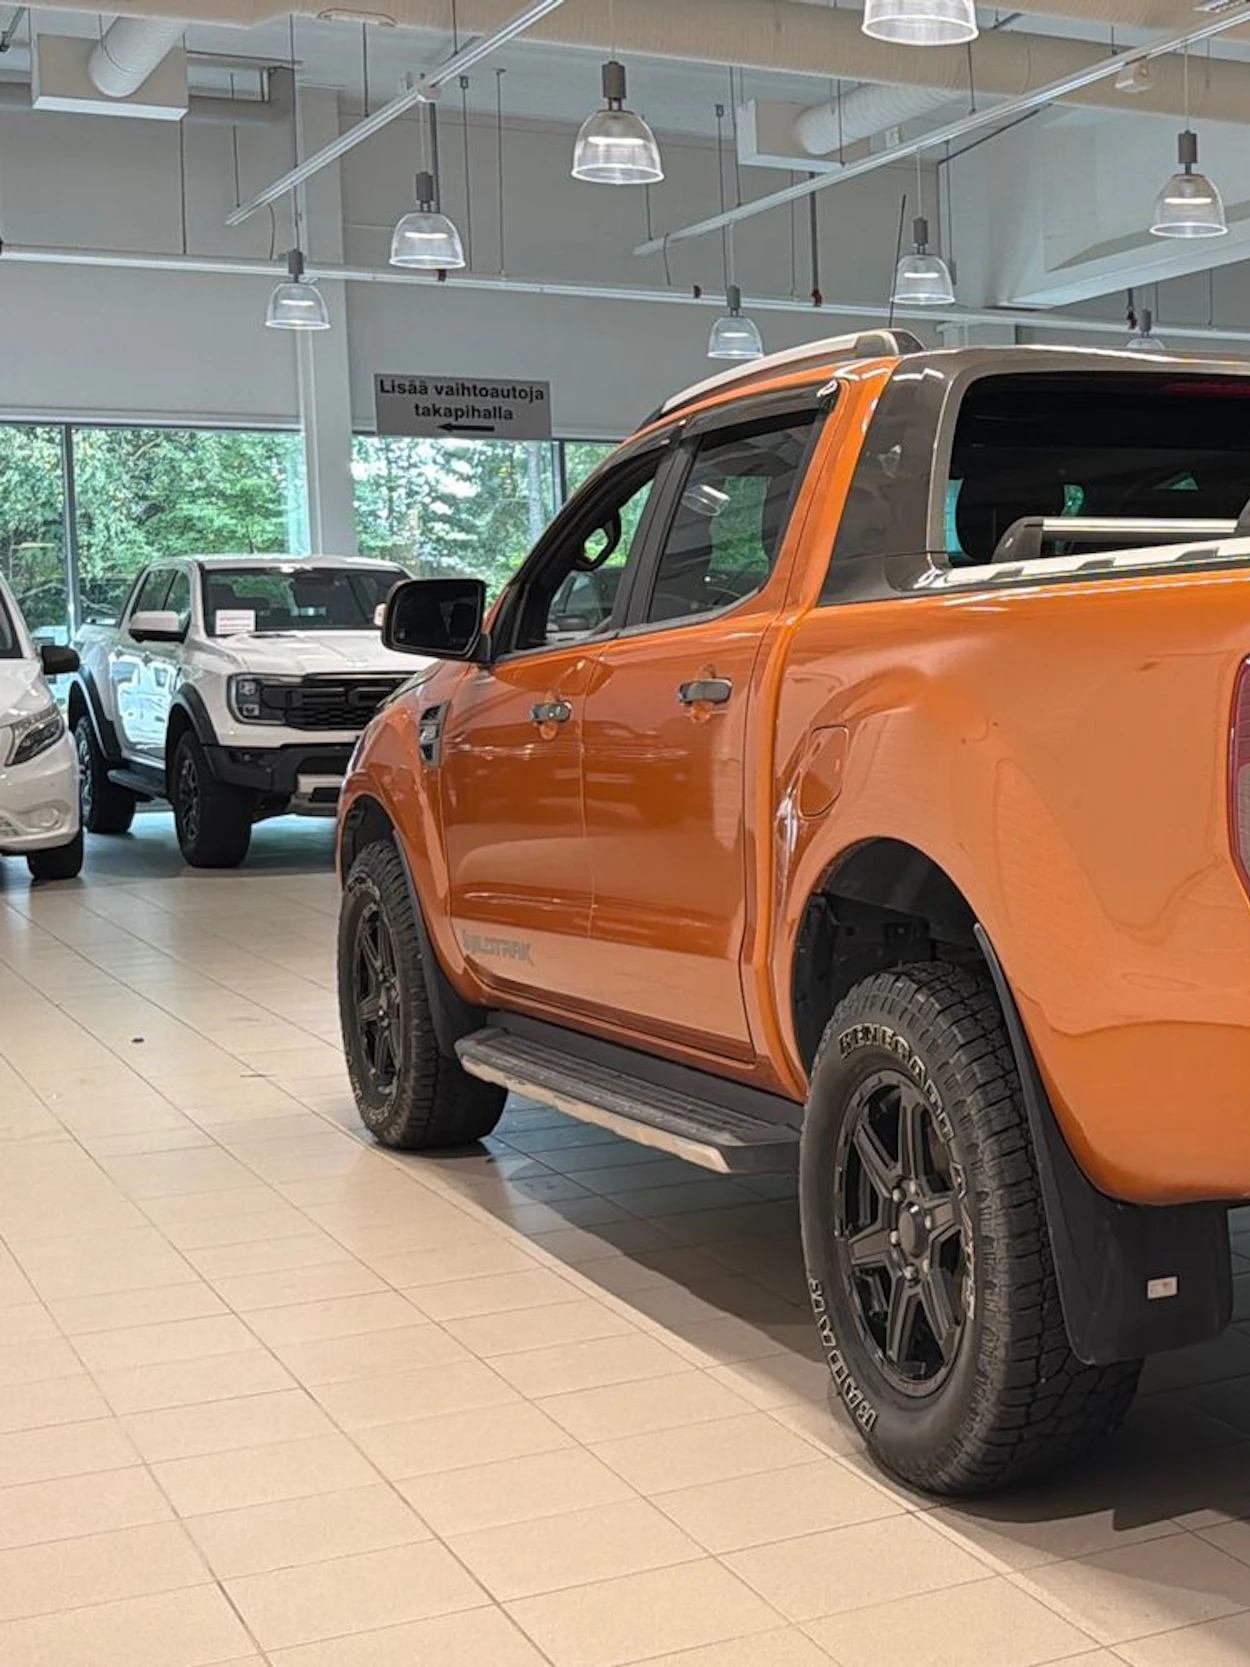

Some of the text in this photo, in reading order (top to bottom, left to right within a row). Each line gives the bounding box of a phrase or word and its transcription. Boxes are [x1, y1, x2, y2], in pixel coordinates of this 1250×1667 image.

[380, 379, 545, 402] Lisää vaihtoautoja
[414, 403, 514, 421] takapihalla
